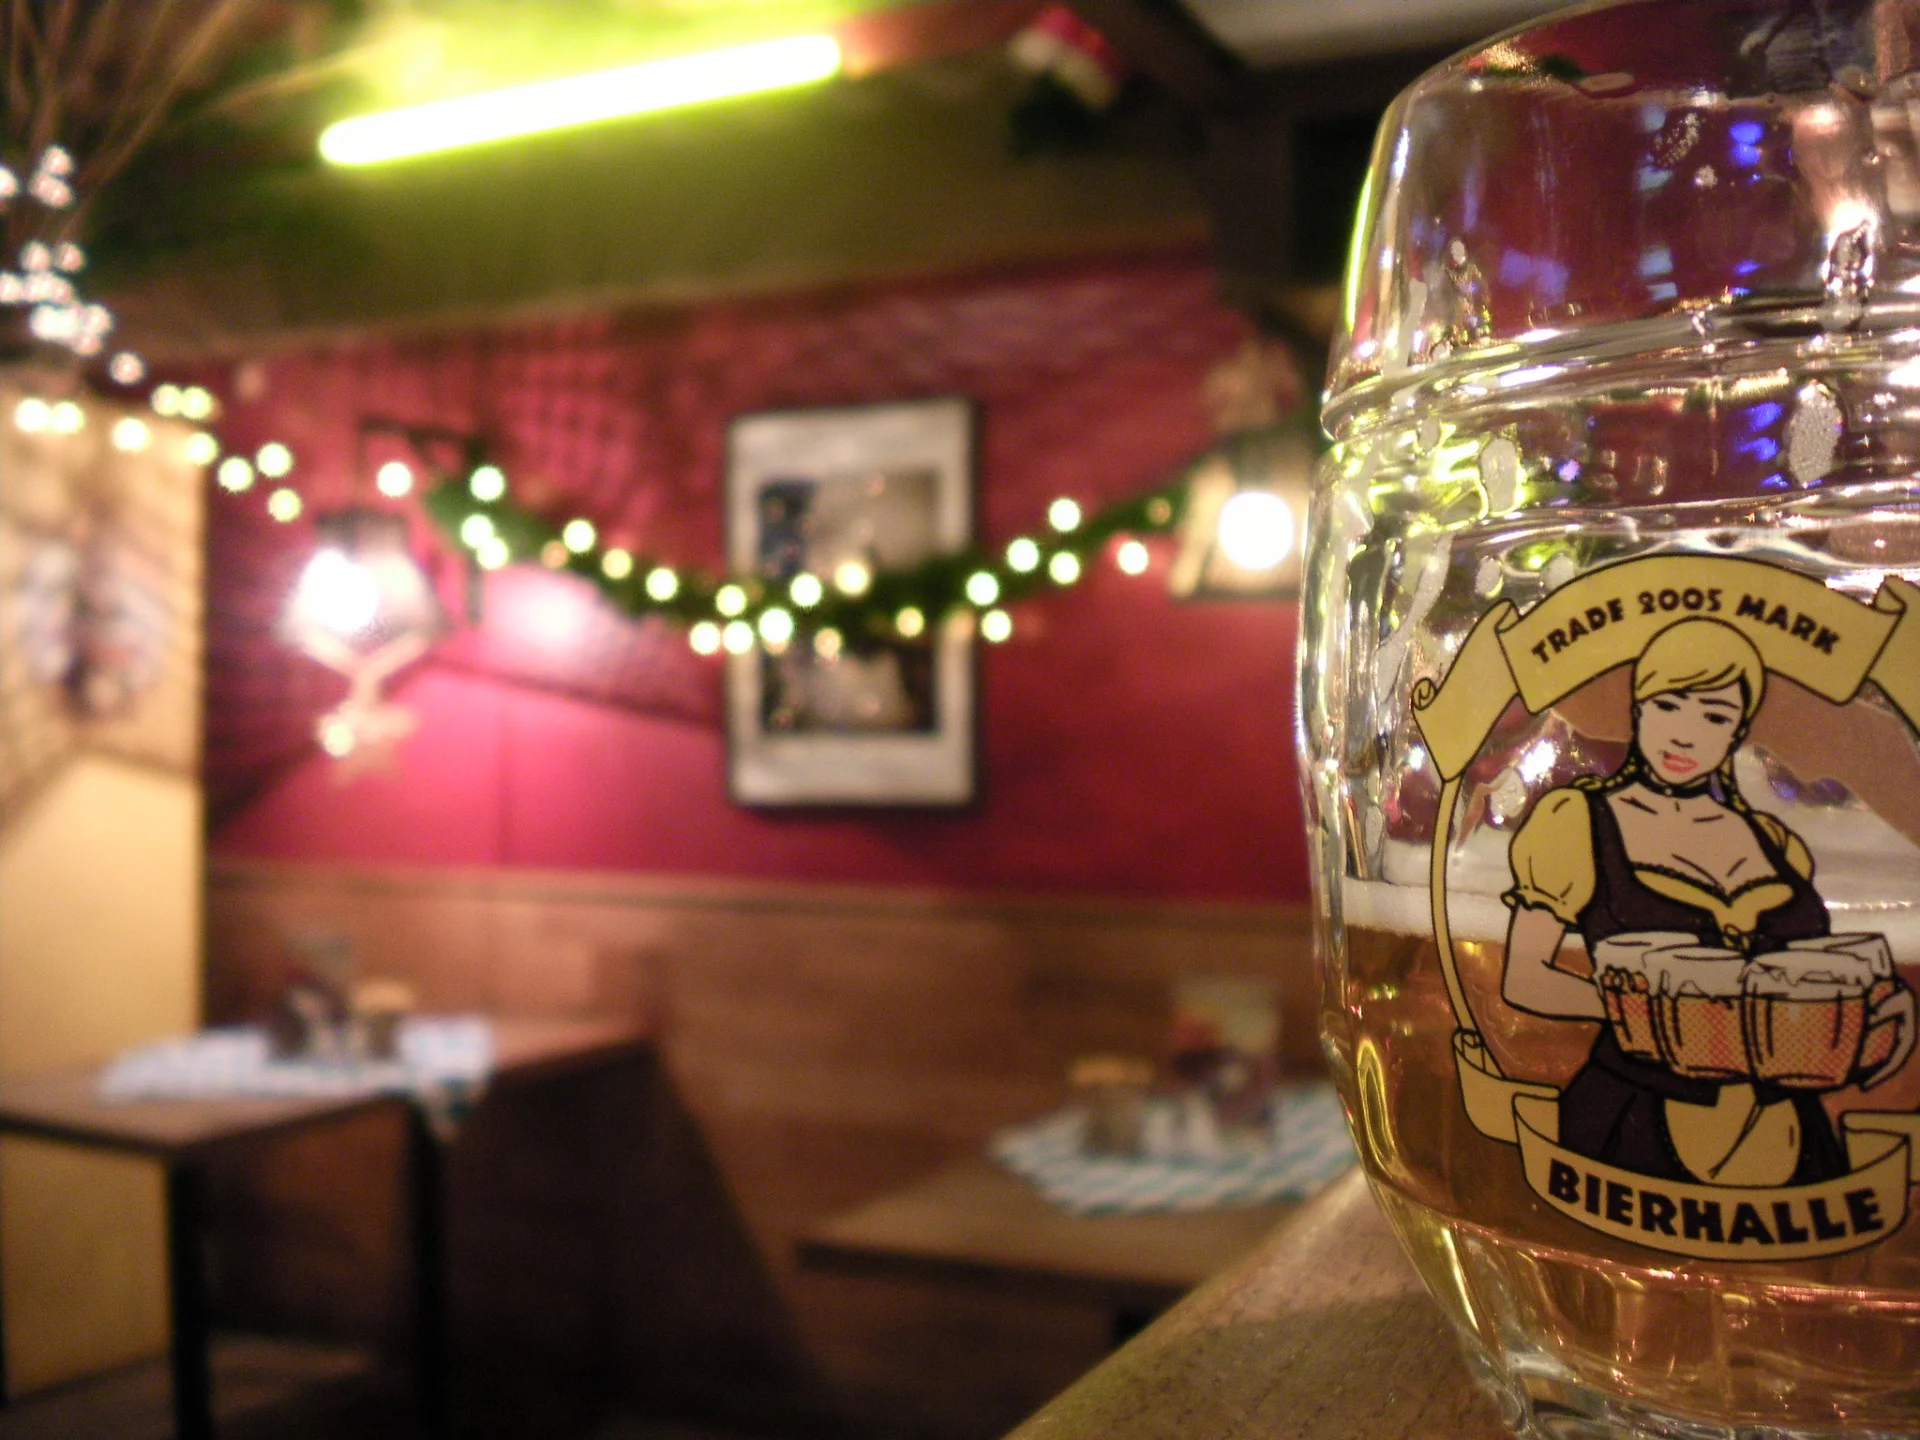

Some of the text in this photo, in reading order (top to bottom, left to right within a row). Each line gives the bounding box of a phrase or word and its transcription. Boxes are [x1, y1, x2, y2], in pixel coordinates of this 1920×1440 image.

[1531, 587, 1840, 664] TRADE 2005 MARK
[1548, 1158, 1884, 1245] BIERHALLE
